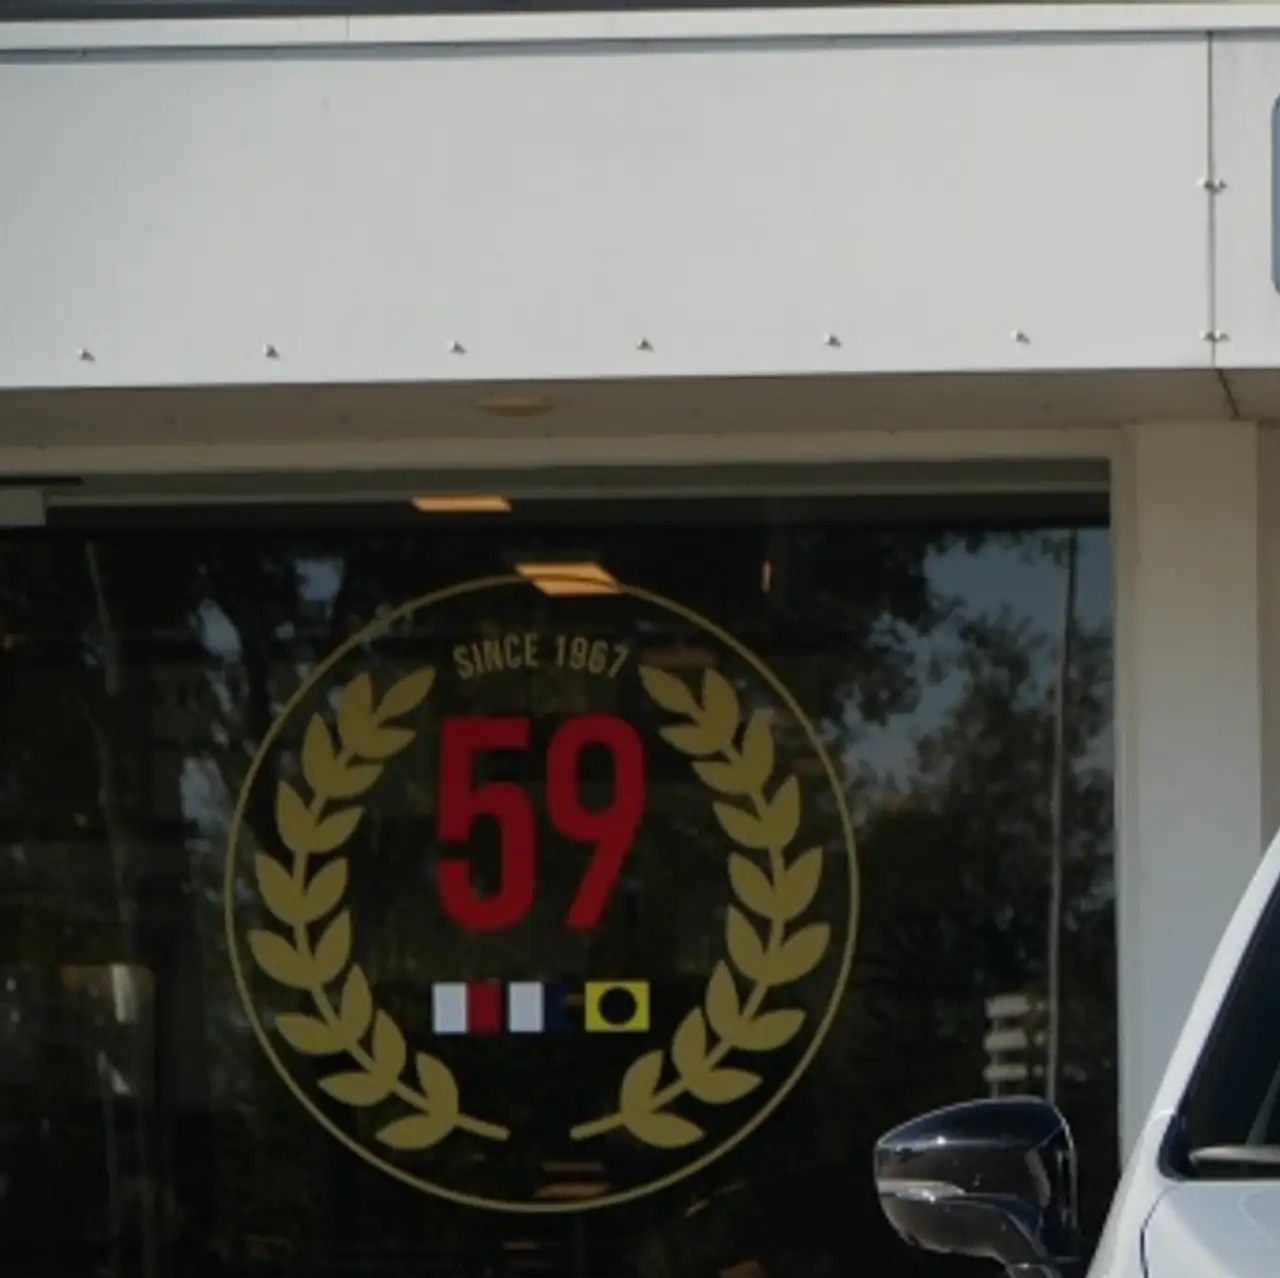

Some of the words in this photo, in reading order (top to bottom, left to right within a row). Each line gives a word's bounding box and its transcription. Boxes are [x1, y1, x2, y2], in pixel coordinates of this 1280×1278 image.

[453, 633, 540, 680] SINCE
[556, 634, 629, 678] 1967
[437, 713, 646, 931] 59
